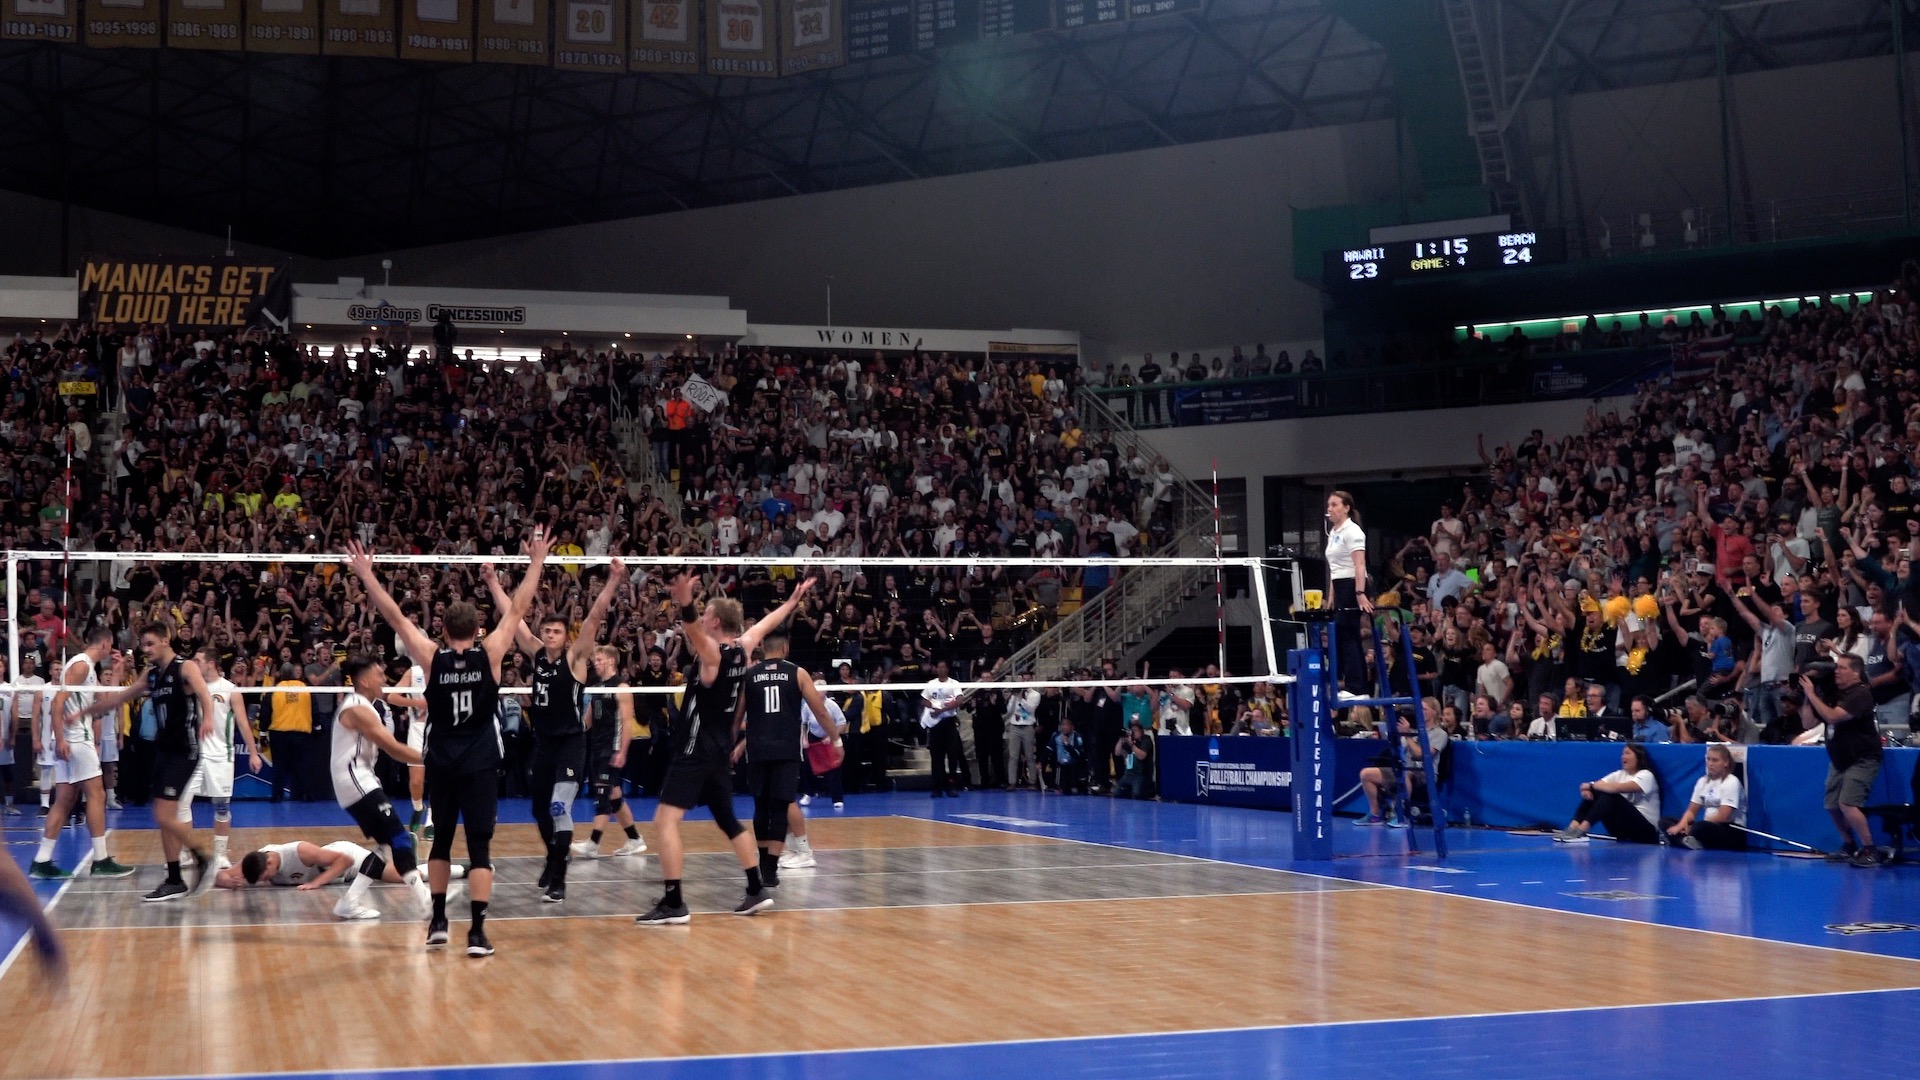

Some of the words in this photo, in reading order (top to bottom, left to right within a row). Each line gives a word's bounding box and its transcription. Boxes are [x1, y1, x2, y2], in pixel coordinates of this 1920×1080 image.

[577, 9, 605, 33] 20
[650, 5, 680, 29] 42
[799, 11, 823, 37] 32
[727, 18, 753, 42] 30
[1415, 238, 1469, 259] 1:15
[1497, 232, 1536, 247] BEACH
[1456, 256, 1466, 266] 4
[1502, 247, 1533, 265] 24
[81, 262, 213, 295] MANIACS
[219, 265, 275, 296] GET
[1349, 262, 1379, 280] 23
[97, 294, 171, 324] LOUD
[177, 295, 251, 326] HERE
[349, 305, 379, 320] 49er
[381, 305, 420, 322] Shops
[817, 329, 911, 346] WOMEN
[686, 382, 714, 405] ROOF
[439, 672, 459, 685] LONG
[753, 673, 770, 684] LONG
[770, 672, 789, 682] BEACH
[450, 689, 474, 727] 19
[763, 685, 781, 714] 10
[1311, 684, 1323, 840] VOLLEYBALL
[1209, 769, 1245, 786] VOLLEYBALL
[1245, 770, 1292, 787] CHAMPIONSHIP
